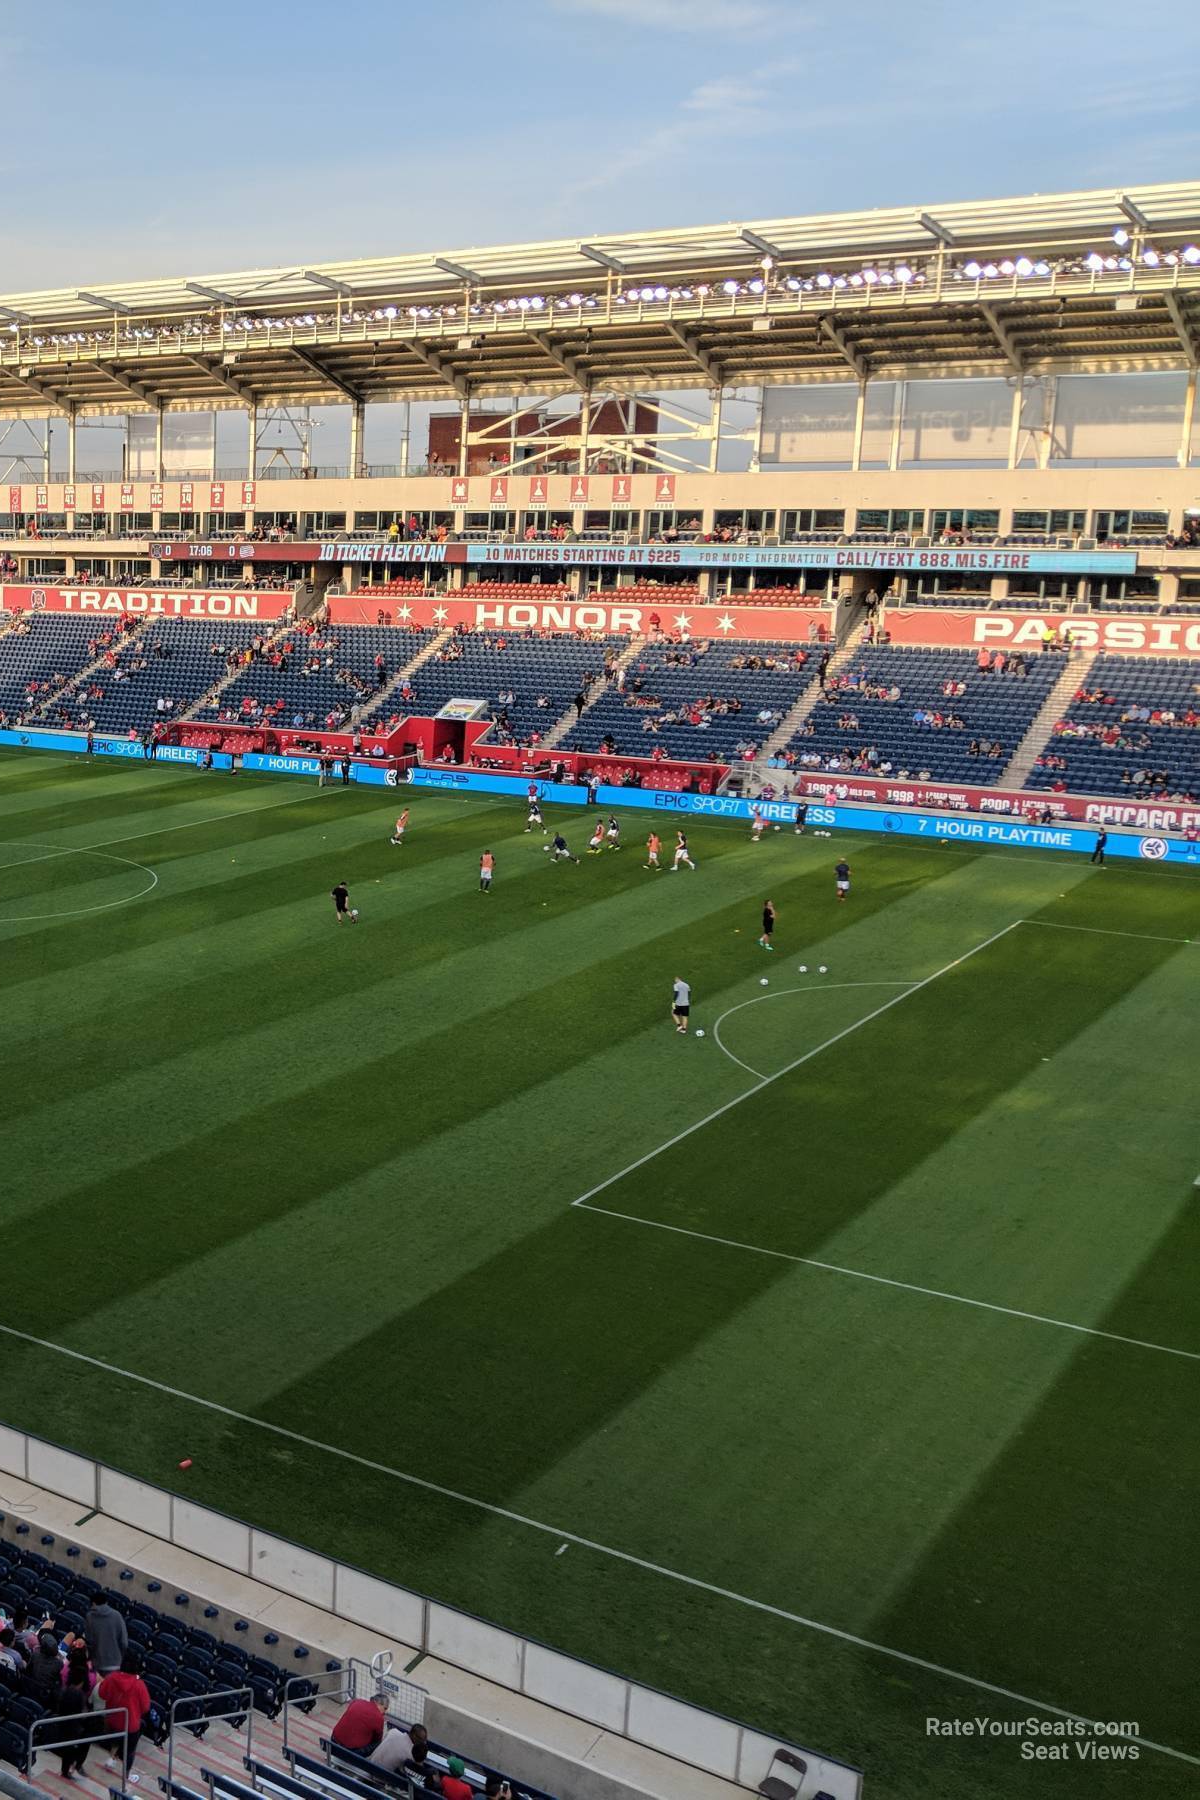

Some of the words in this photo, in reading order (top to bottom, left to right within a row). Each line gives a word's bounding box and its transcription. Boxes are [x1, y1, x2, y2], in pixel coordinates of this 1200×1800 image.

[151, 493, 162, 504] HC
[181, 493, 191, 504] 14
[214, 492, 221, 504] 2
[245, 492, 252, 503] 9
[165, 545, 172, 556] 0
[189, 545, 213, 556] 17:06
[228, 545, 236, 557] 0
[318, 544, 335, 561] 10
[335, 544, 379, 561] TICKET
[380, 545, 412, 561] FLEX
[412, 545, 447, 562] PLAN
[485, 547, 499, 560] 10
[503, 548, 559, 561] MATCHES
[563, 549, 625, 562] STARTING
[628, 550, 645, 562] AT
[647, 549, 681, 564] $225
[699, 552, 718, 561] FOR
[722, 552, 750, 563] MORE
[754, 553, 829, 564] INFORMATION
[836, 551, 915, 567] CALL/TEXT
[919, 553, 1031, 569] 888.MLS.FIRE
[59, 590, 258, 616] TRADITION
[475, 604, 643, 632] HONOR
[92, 741, 114, 753] EPIC
[155, 747, 198, 762] WIRELES
[257, 757, 264, 767] 7
[269, 758, 299, 771] HOUR
[654, 793, 688, 808] EPIC
[692, 796, 742, 815] SPORT
[886, 789, 915, 803] 1998
[1086, 803, 1177, 831] CHICAGO
[917, 819, 928, 832] 7
[935, 821, 984, 838] HOUR
[987, 825, 1073, 847] PLAYTIME
